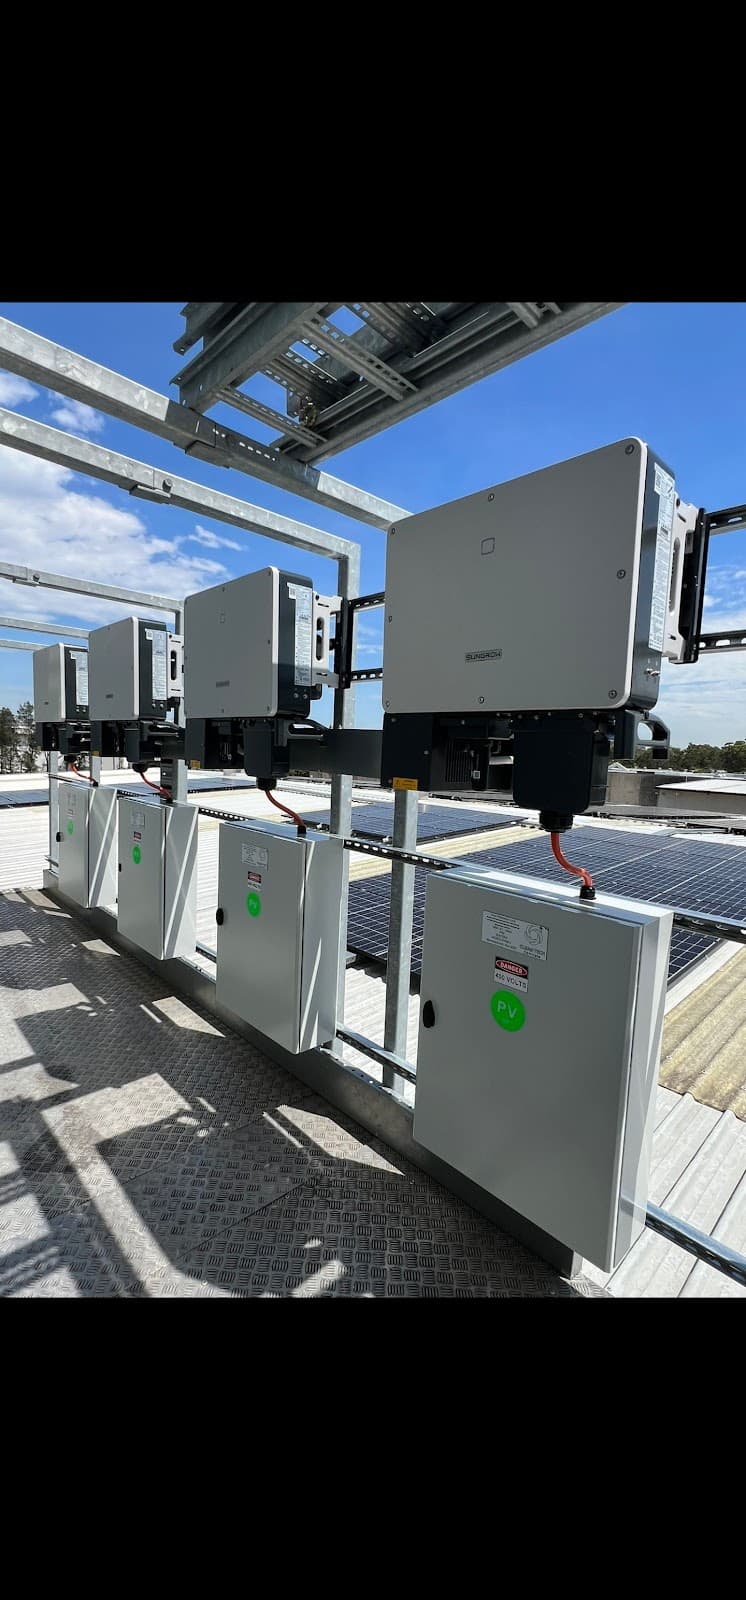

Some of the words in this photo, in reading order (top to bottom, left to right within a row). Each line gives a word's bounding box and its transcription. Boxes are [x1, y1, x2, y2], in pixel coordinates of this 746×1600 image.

[500, 961, 523, 974] DANGER
[507, 976, 527, 988] VOLTS
[497, 1000, 517, 1018] PV
